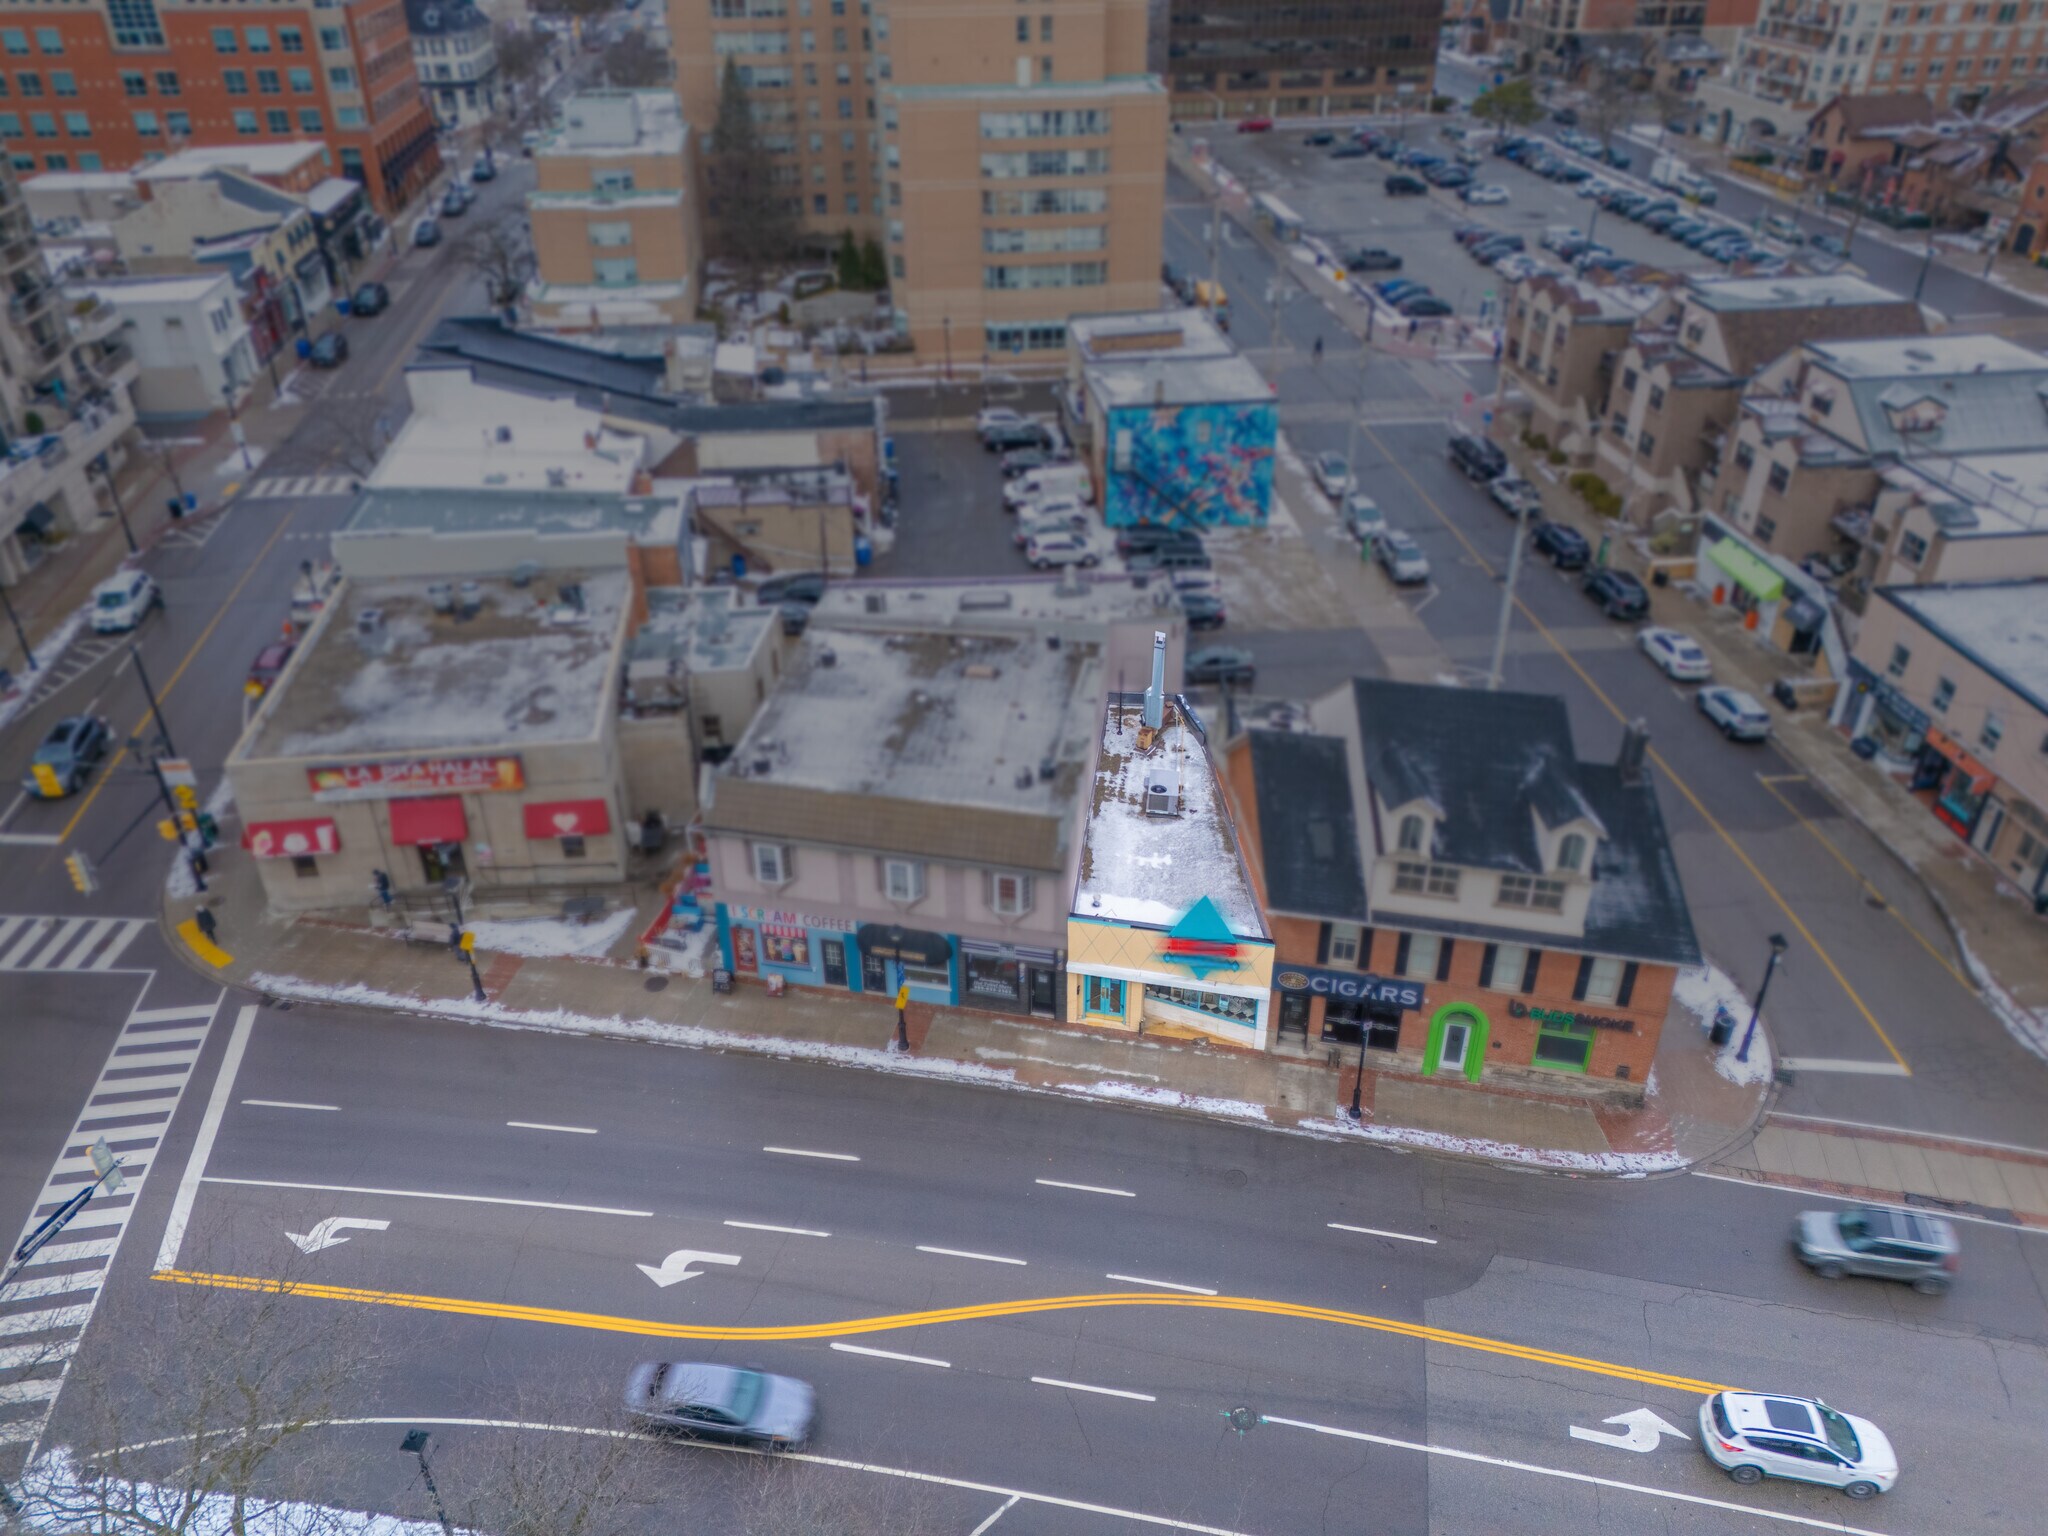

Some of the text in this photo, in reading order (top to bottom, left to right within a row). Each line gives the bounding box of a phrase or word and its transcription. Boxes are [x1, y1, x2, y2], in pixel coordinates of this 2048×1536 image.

[430, 759, 494, 774] HALAL
[740, 906, 797, 925] SCREAM
[803, 914, 852, 932] COFFEE
[1310, 976, 1418, 1006] CIGARS
